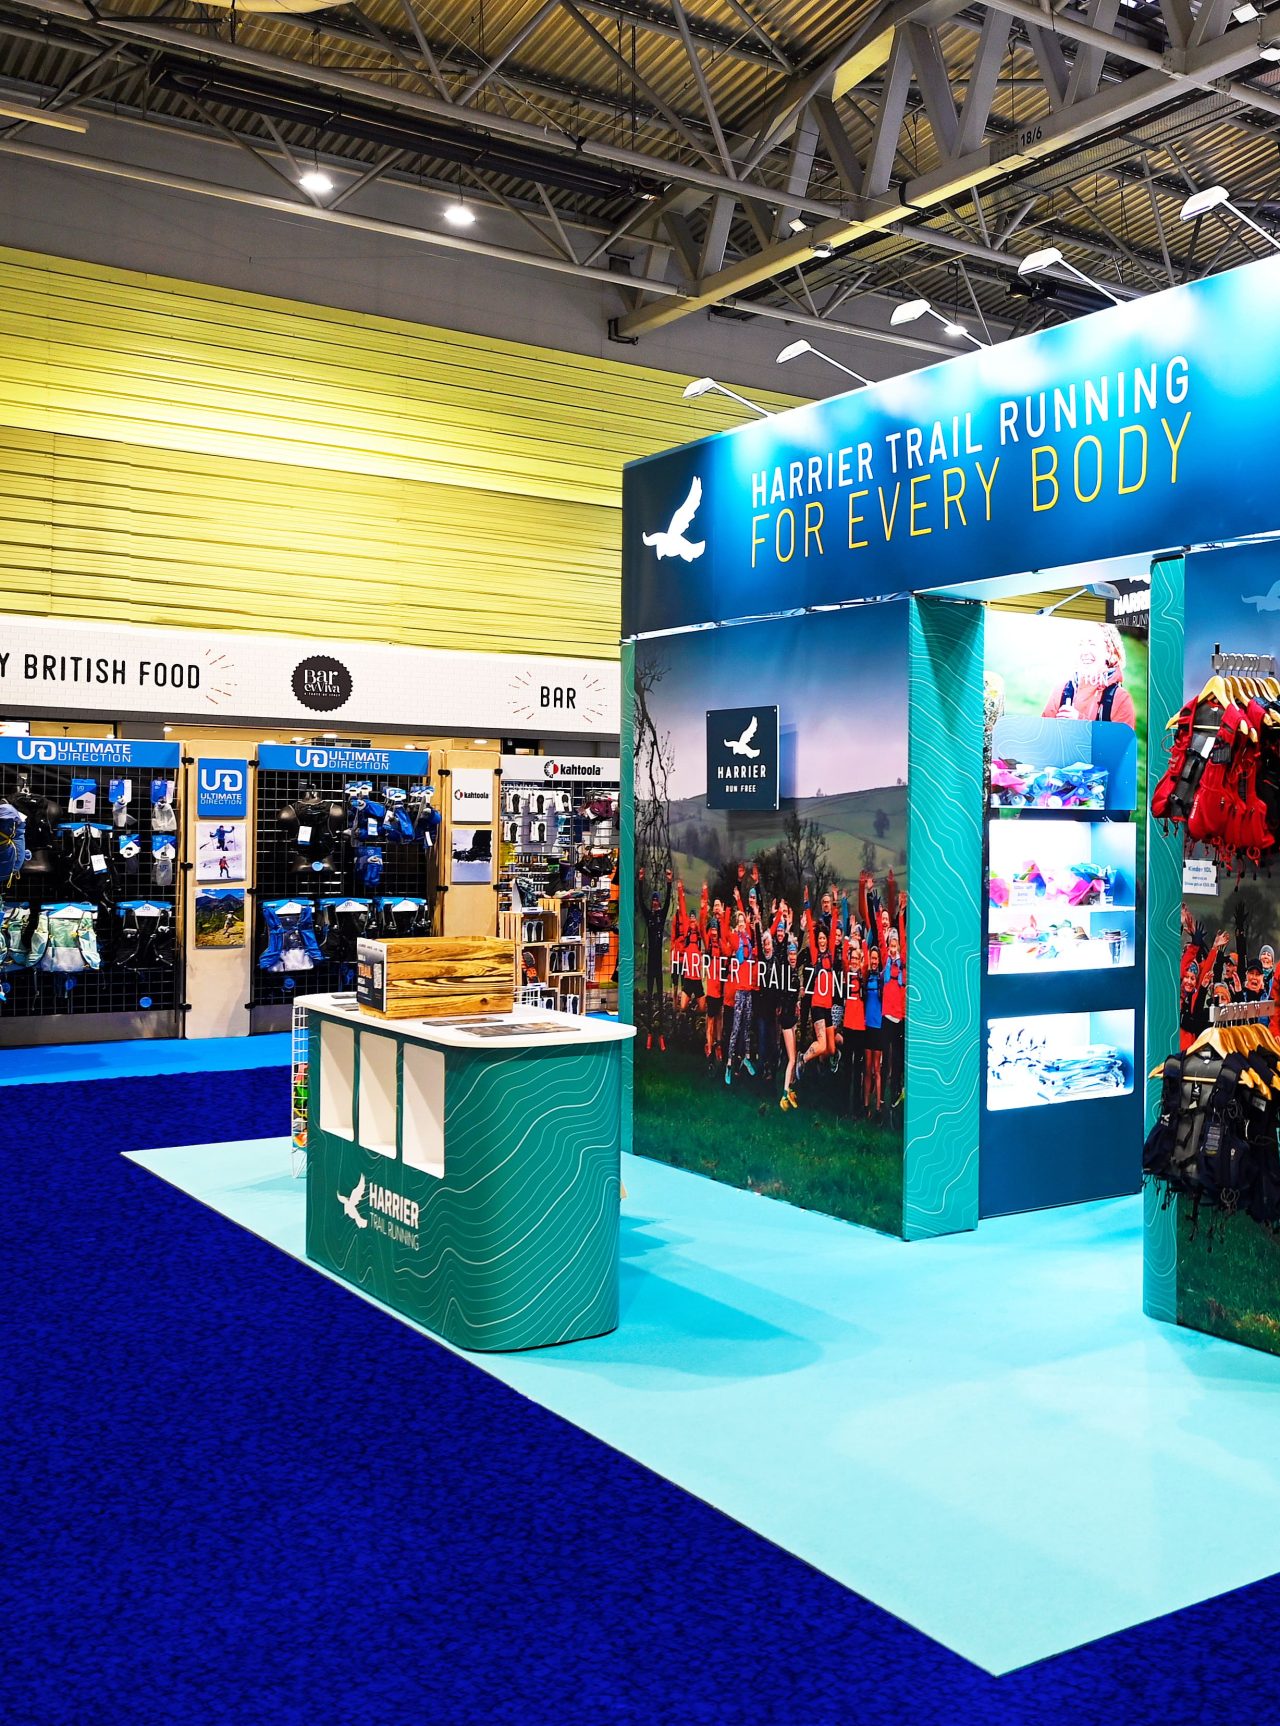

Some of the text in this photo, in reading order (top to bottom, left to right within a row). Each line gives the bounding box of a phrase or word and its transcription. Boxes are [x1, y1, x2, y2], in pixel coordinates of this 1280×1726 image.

[1020, 126, 1043, 147] 18/6
[751, 355, 1189, 509] HARRIER TRAIL RUNNING
[751, 410, 1192, 569] FOR EVERY BODY
[24, 653, 126, 685] BRITISH
[139, 661, 200, 689] FOOD
[304, 669, 339, 685] Bar
[540, 685, 577, 710] BAR
[58, 741, 132, 754] ULTIMATE
[58, 752, 132, 763] DIRECTION
[328, 750, 389, 762] ULTIMATE
[328, 760, 390, 771] DIRECTION
[560, 763, 601, 776] kahtoola
[717, 764, 767, 779] HARRIER
[200, 792, 242, 800] ULTIMATE
[464, 790, 490, 799] kahtoola
[725, 784, 757, 793] RUN FREE
[671, 950, 858, 1000] HARRIER TRAIL ZONE
[369, 1182, 419, 1230] HARRIER
[369, 1211, 420, 1251] TRAIL RUNNING
